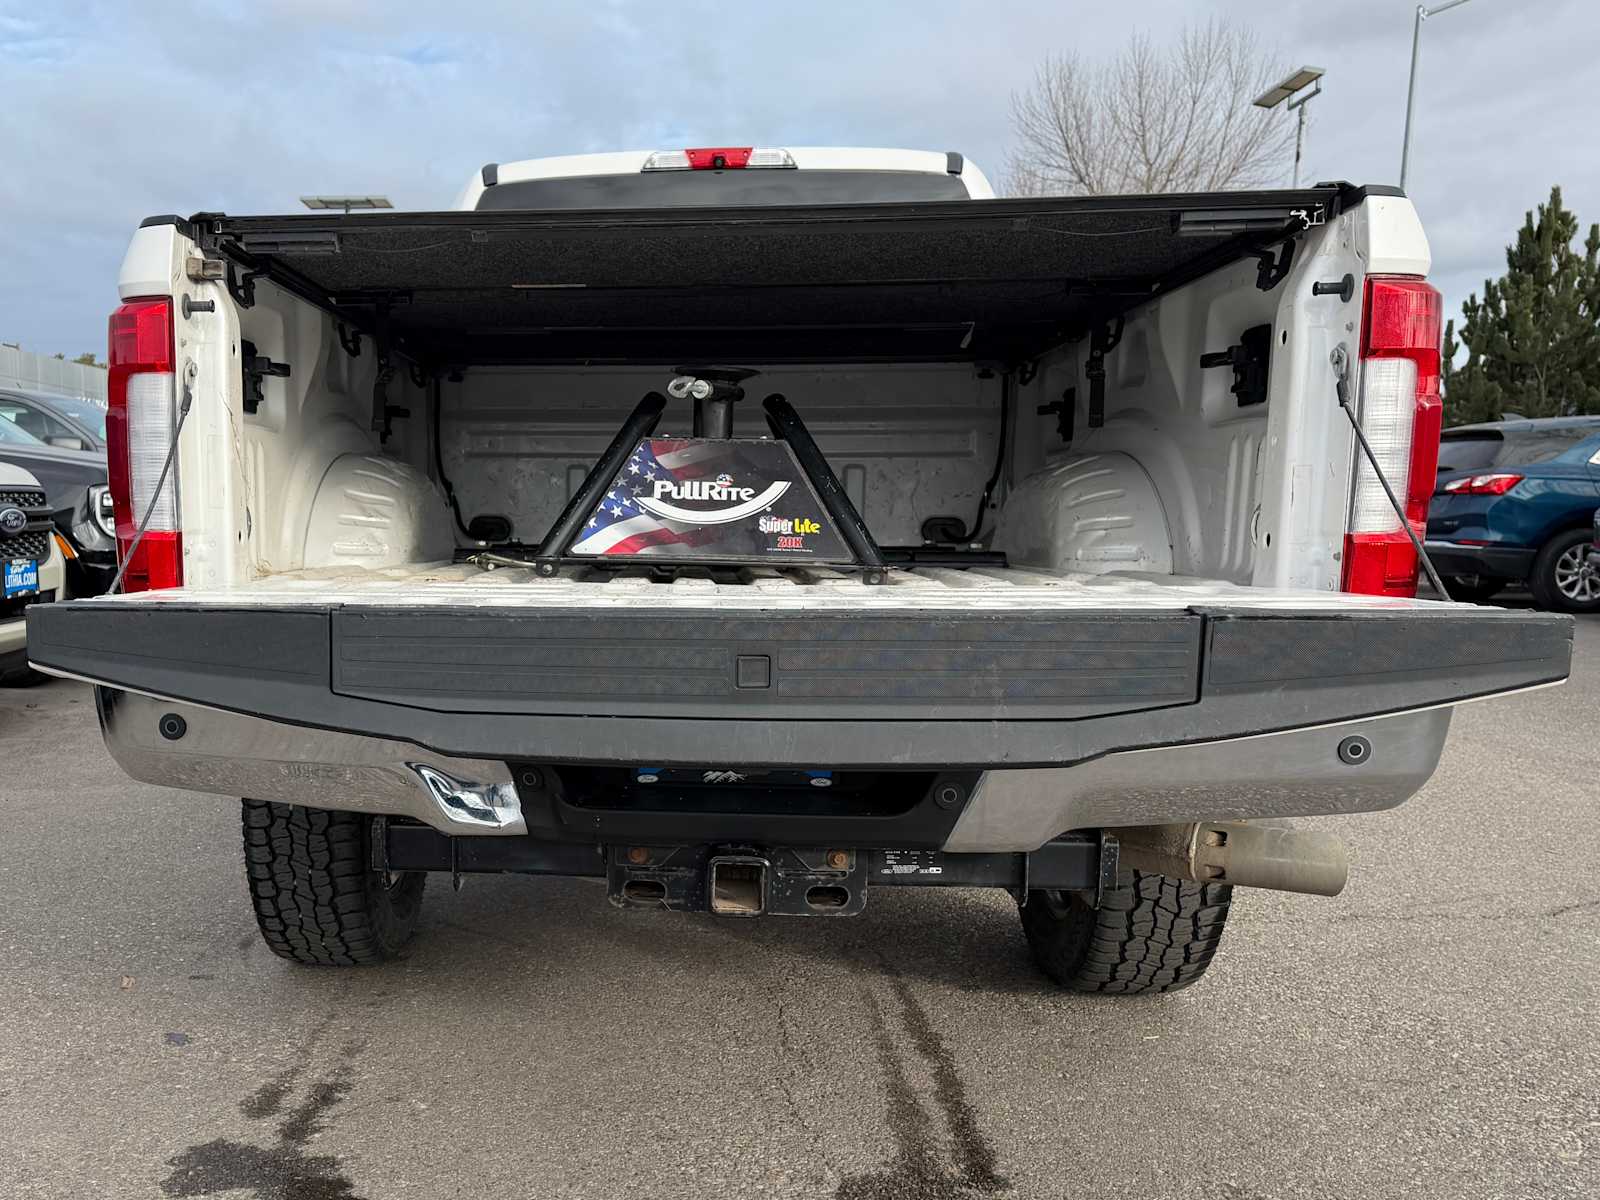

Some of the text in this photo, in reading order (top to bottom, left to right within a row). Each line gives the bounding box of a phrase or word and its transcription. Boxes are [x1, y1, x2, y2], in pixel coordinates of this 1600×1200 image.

[654, 480, 755, 501] PullRite
[759, 517, 821, 534] Super Lite
[777, 536, 803, 548] 20K
